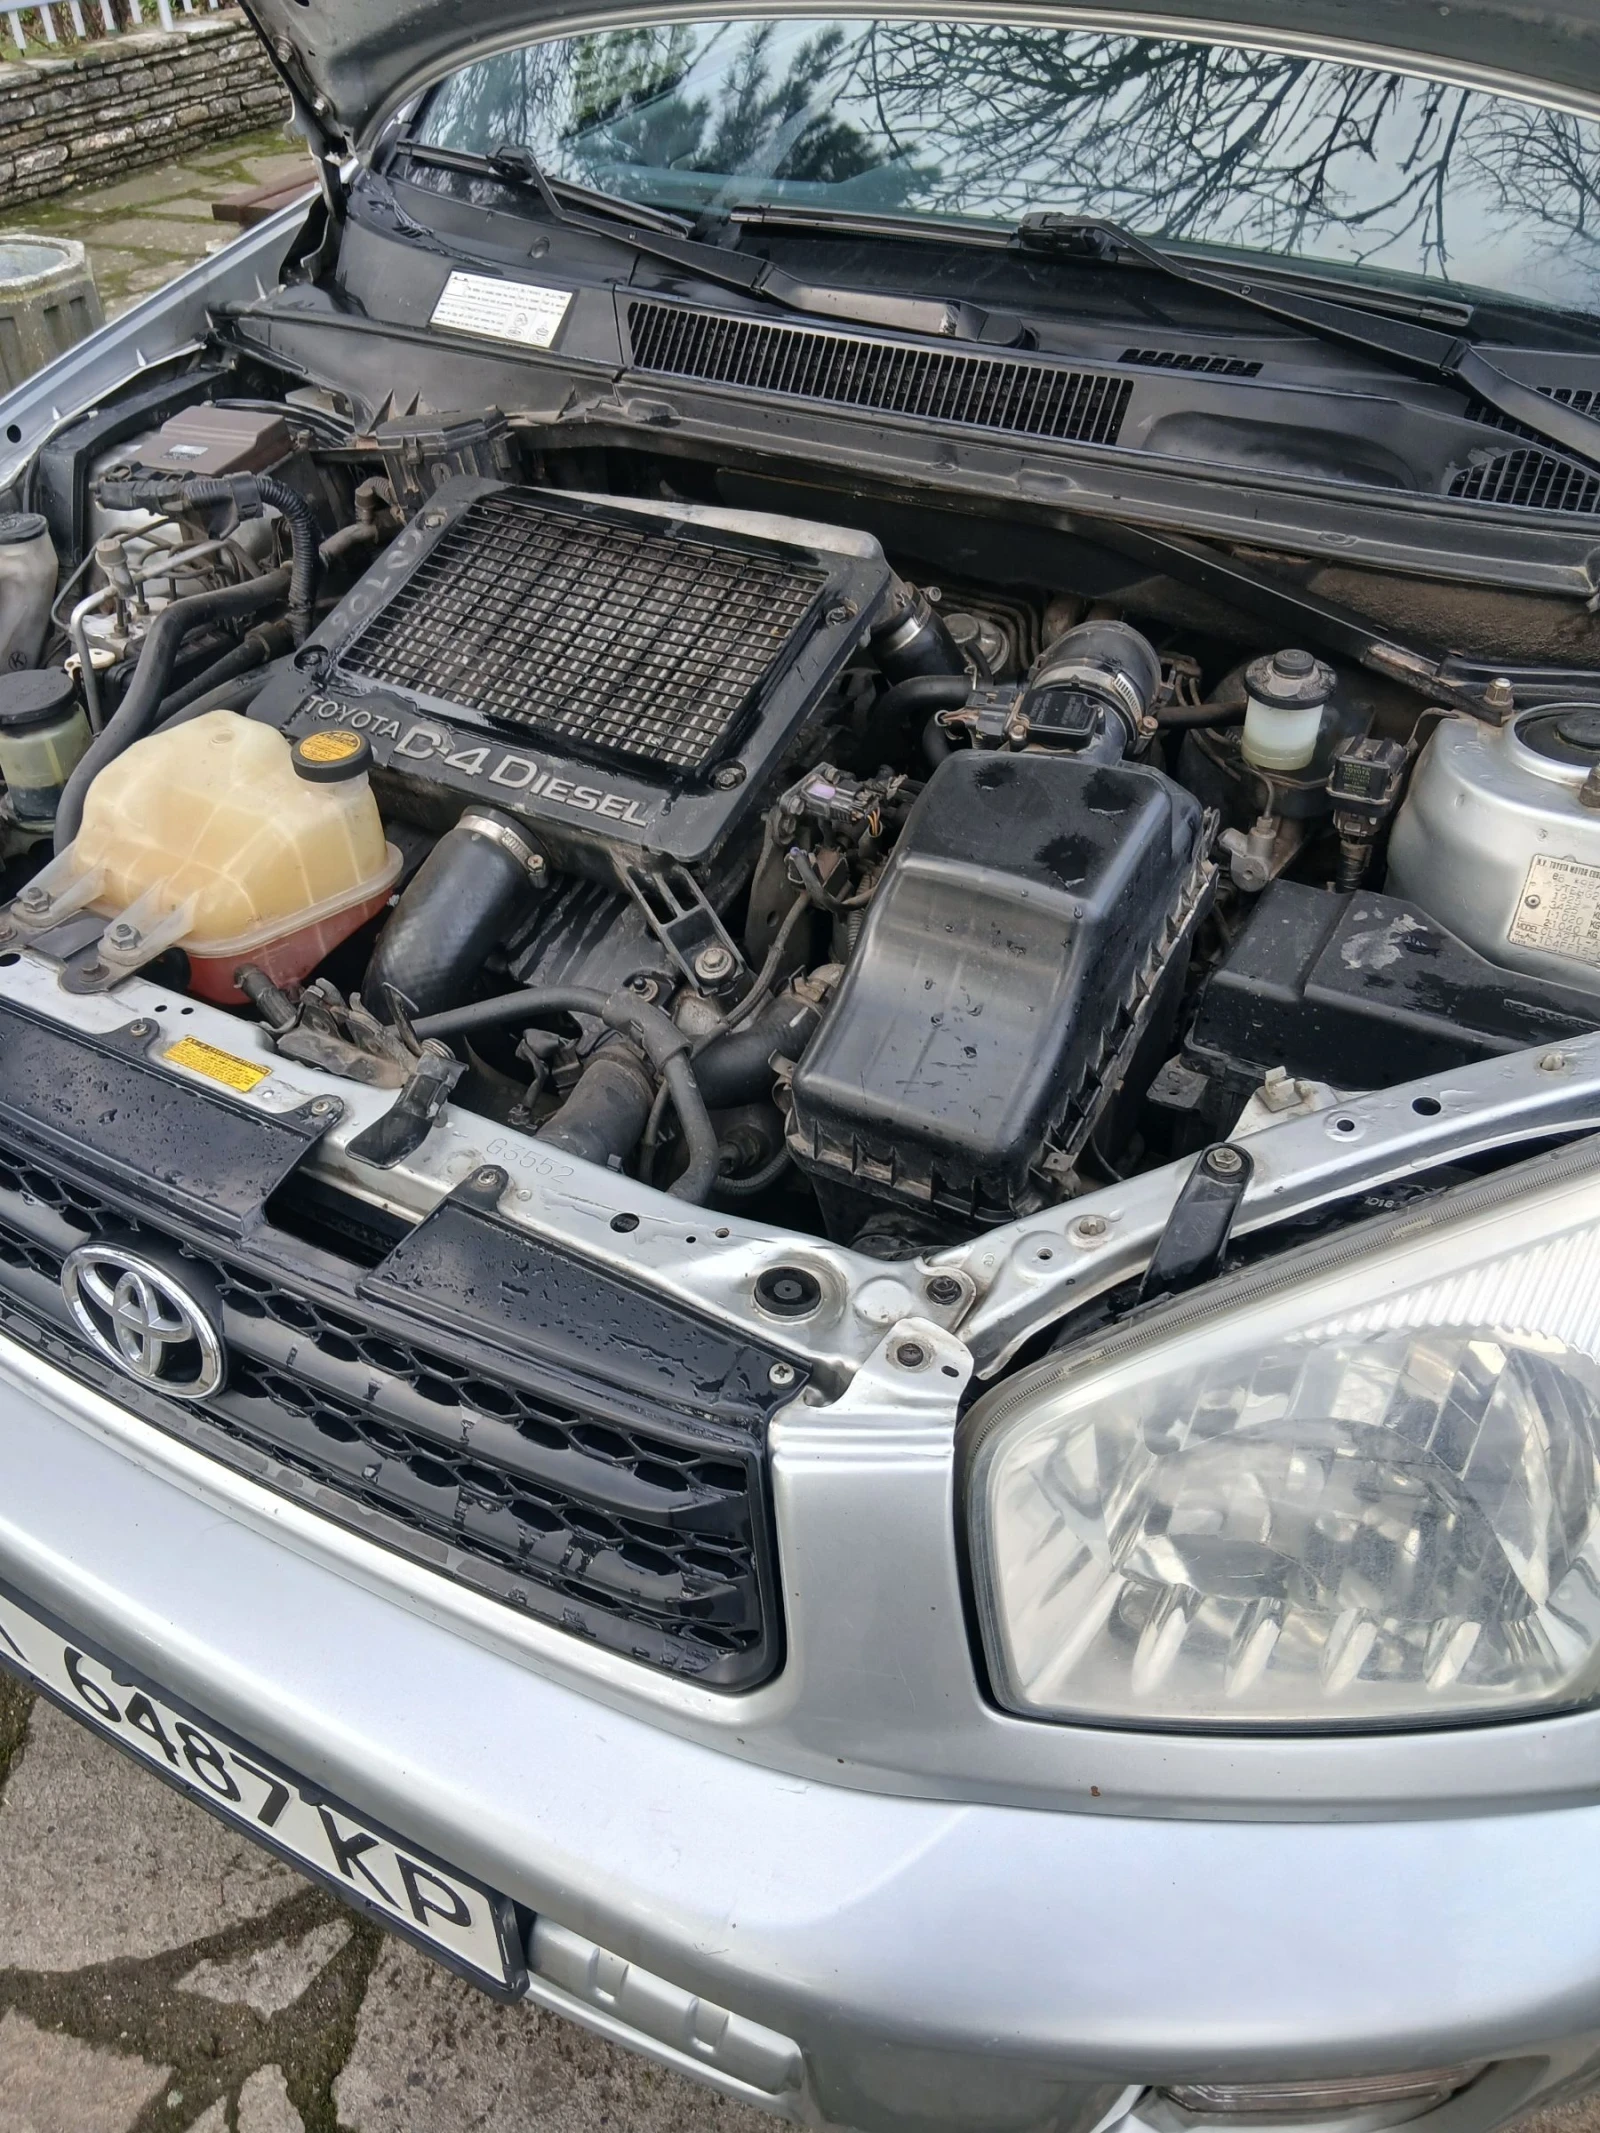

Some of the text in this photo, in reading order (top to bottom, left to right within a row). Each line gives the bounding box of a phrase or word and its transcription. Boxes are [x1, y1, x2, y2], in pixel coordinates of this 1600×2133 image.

[305, 695, 400, 740] TOYOTA
[489, 755, 648, 827] DIESEL
[1550, 861, 1569, 872] TOYOTA
[1569, 866, 1589, 877] MOTOR
[1516, 922, 1539, 934] MODEL
[1587, 930, 1599, 939] KG
[486, 1138, 575, 1184] G3552
[63, 1645, 473, 1927] 6487 KP
